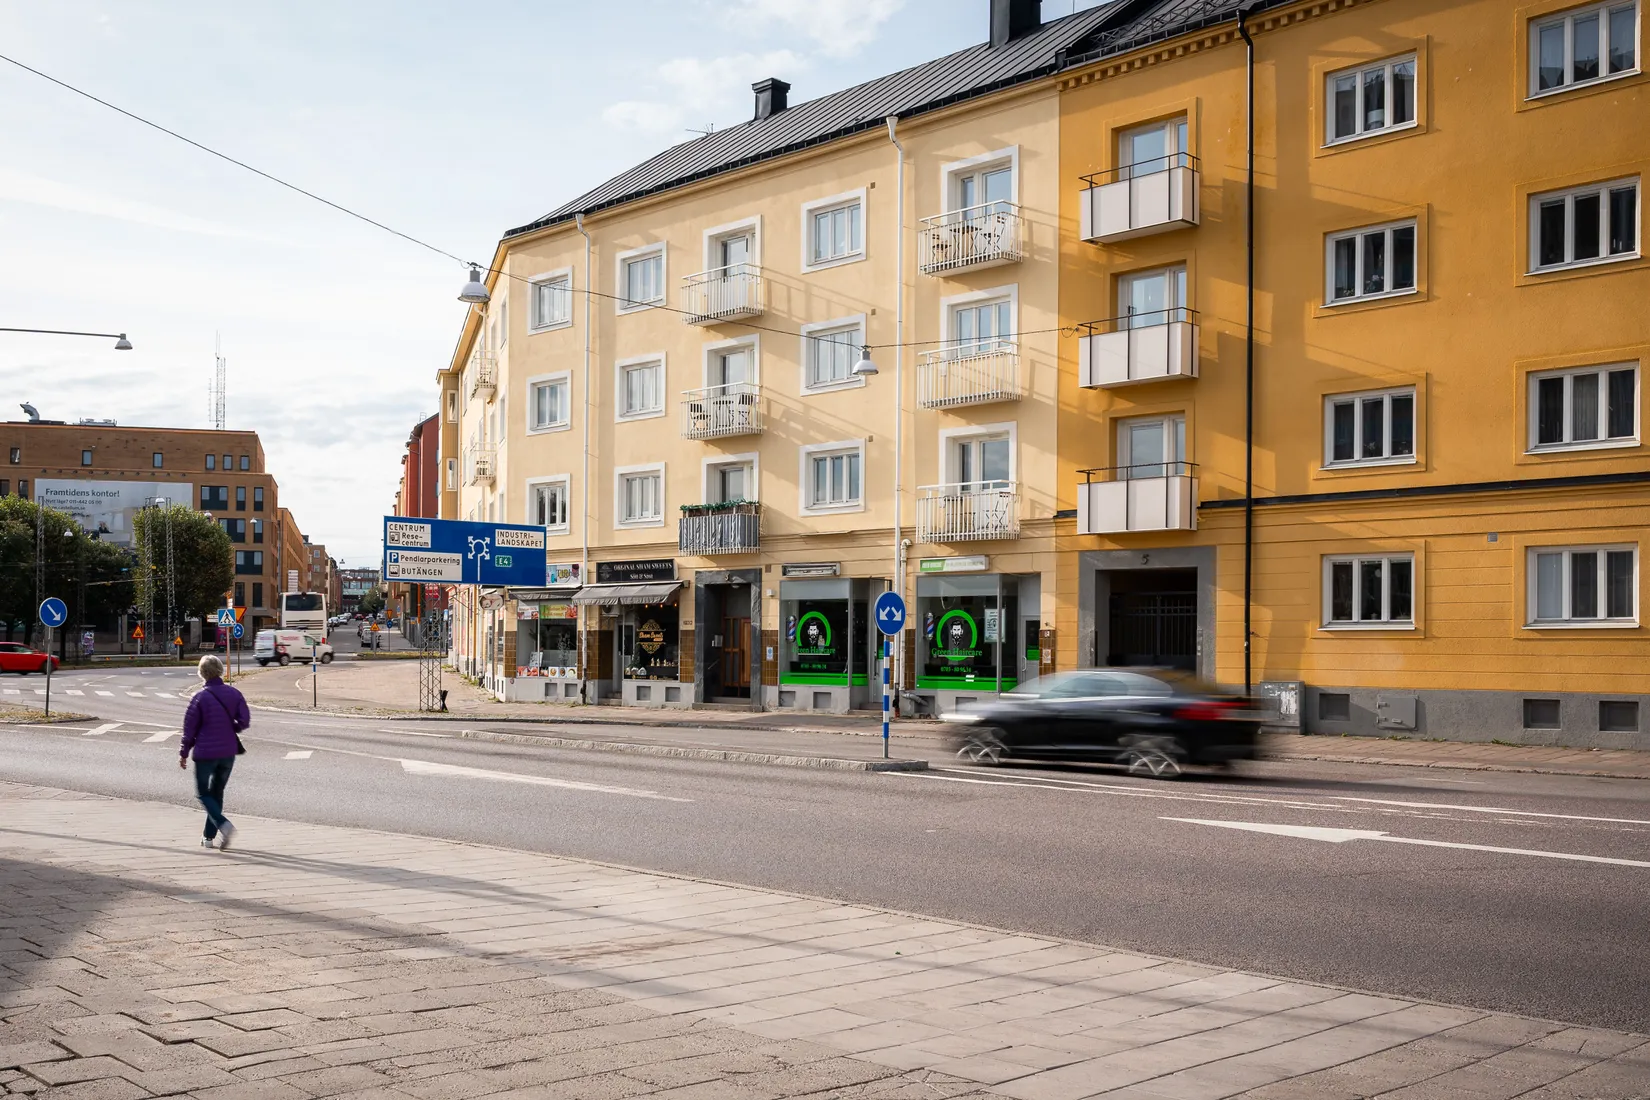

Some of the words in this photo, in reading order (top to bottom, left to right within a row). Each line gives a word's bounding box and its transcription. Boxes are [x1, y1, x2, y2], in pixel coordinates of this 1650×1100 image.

[45, 488, 90, 497] Framtidens
[91, 489, 120, 498] kontor!
[389, 523, 425, 532] CENTRUM
[497, 531, 534, 539] INDUSTRI-
[497, 539, 543, 548] LANDSKAPET
[401, 554, 460, 566] Pendlarparkering
[1140, 554, 1150, 565] 5
[402, 566, 443, 576] BUTÄNGEN
[932, 648, 951, 656] Green
[953, 648, 982, 656] Haircare
